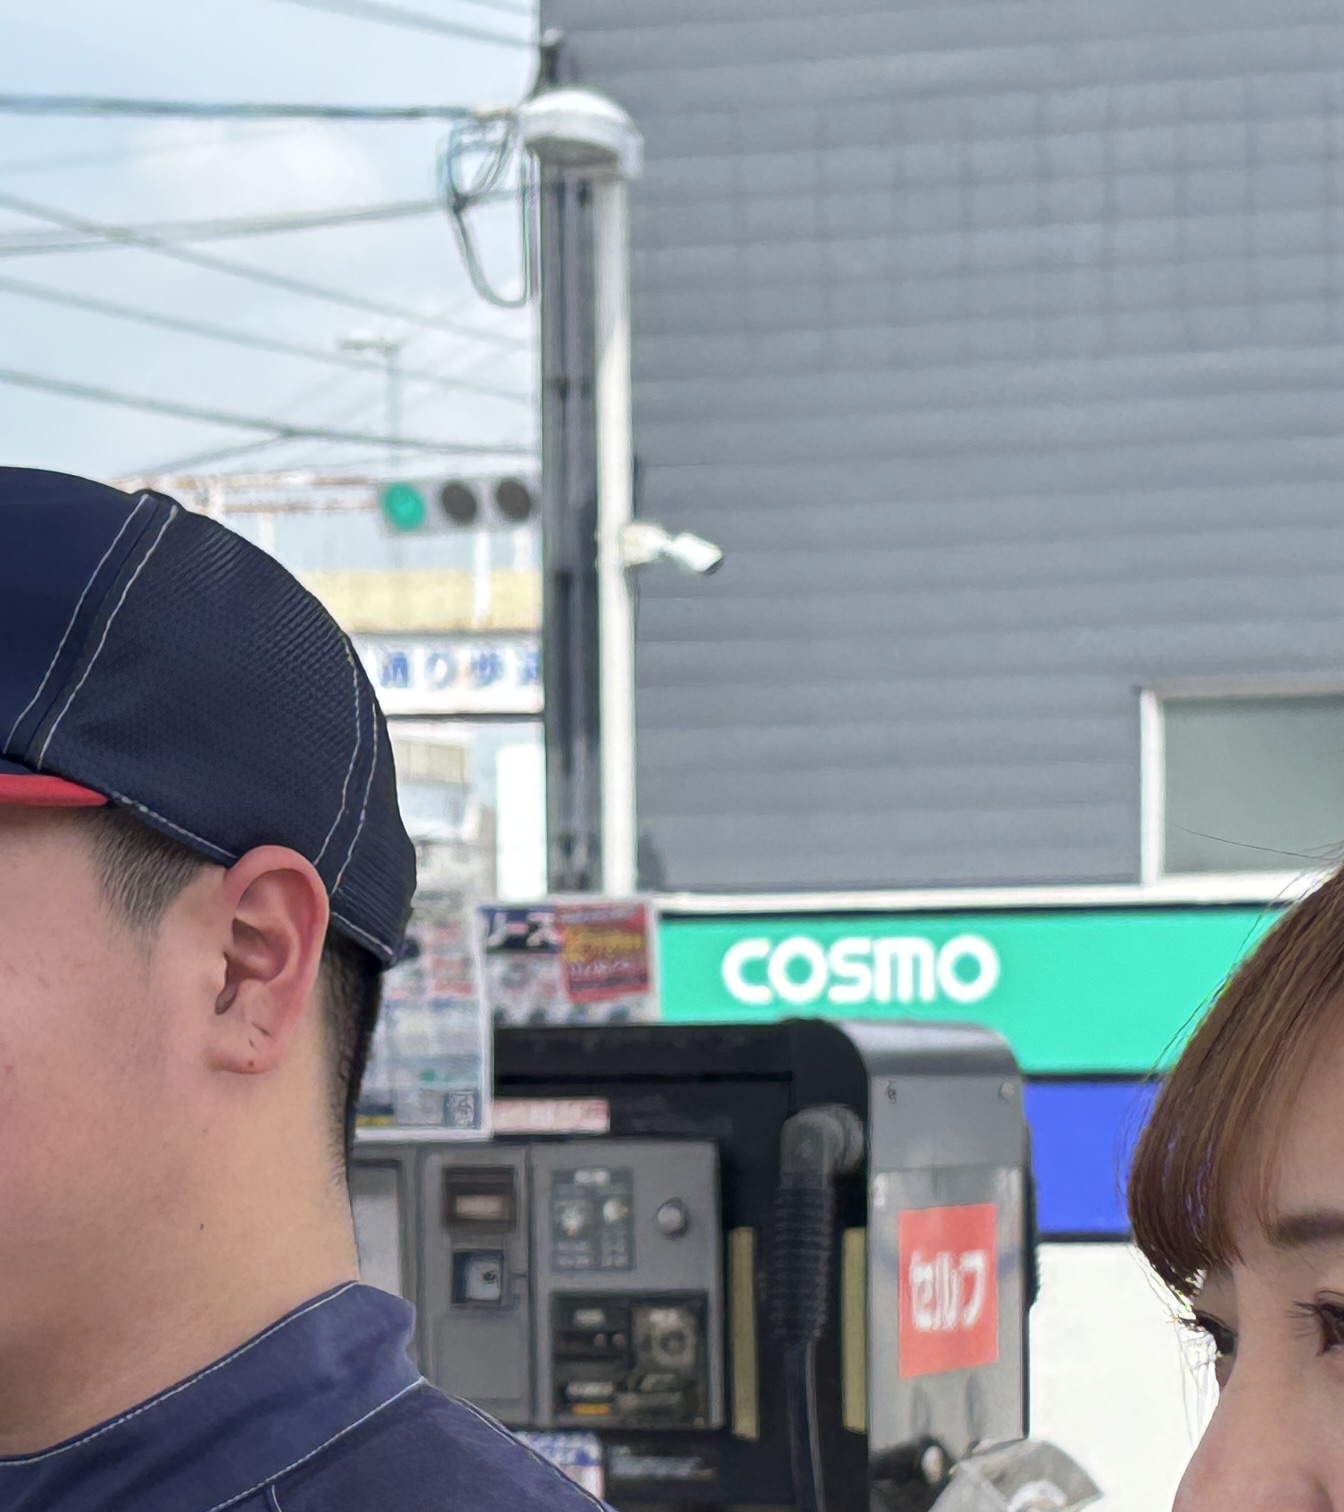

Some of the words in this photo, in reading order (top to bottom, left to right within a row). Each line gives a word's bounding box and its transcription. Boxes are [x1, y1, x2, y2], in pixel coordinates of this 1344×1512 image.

[721, 935, 1001, 1005] COSMO
[909, 1250, 986, 1332] セルフ
